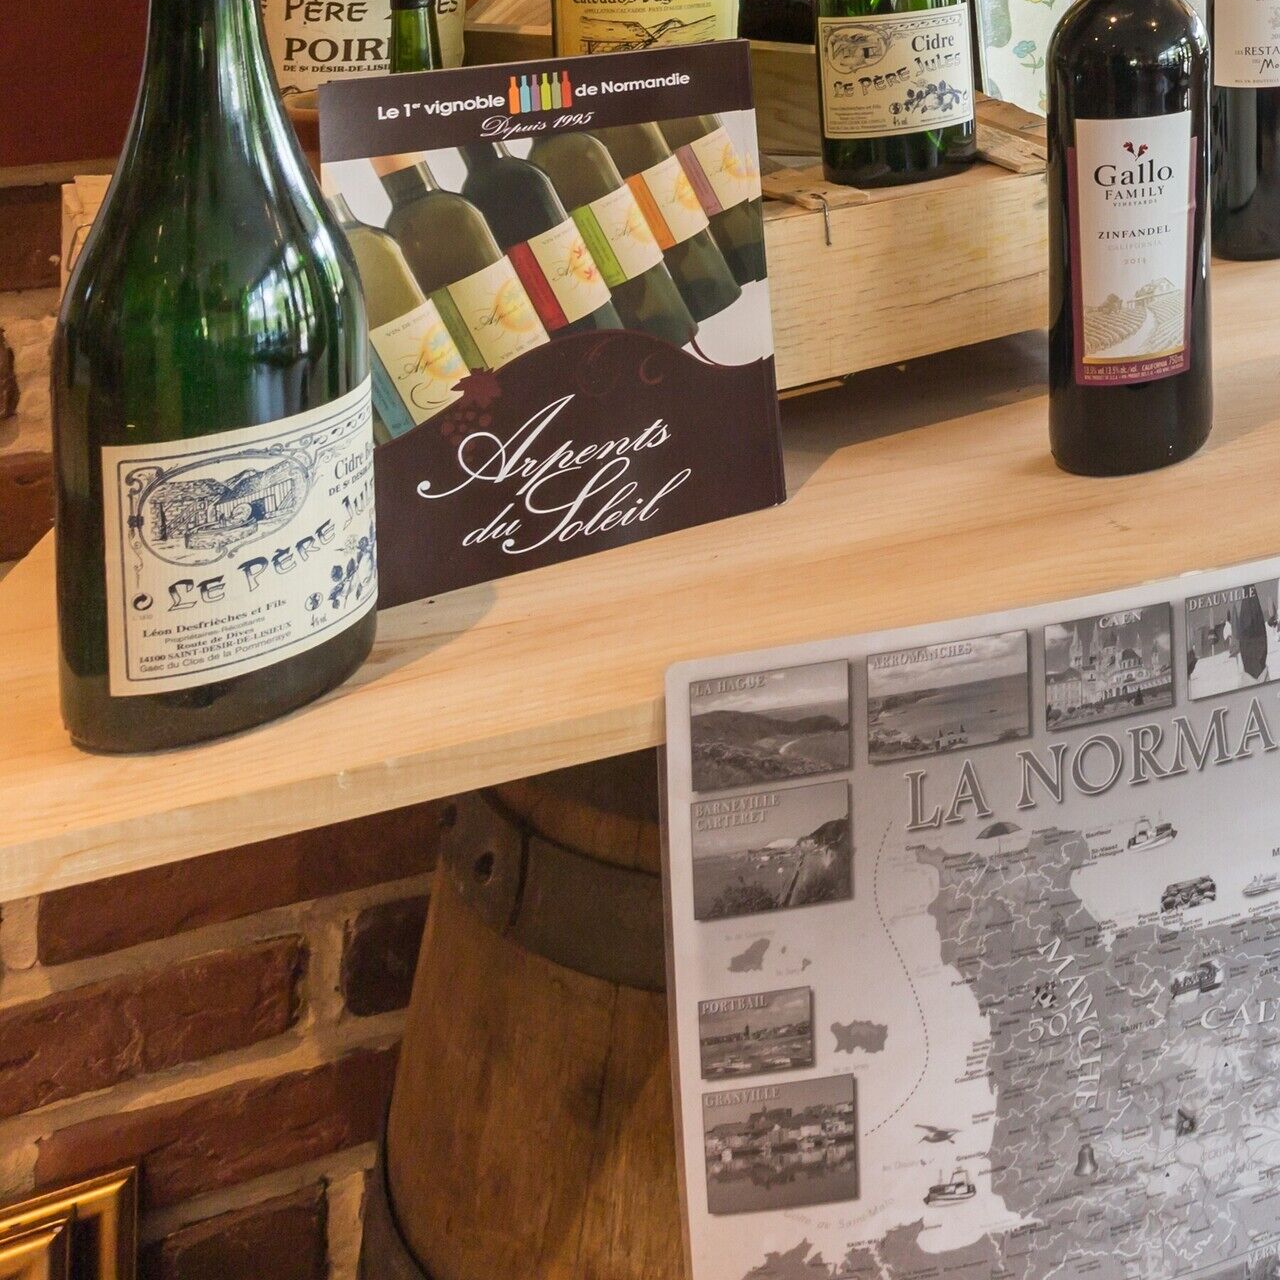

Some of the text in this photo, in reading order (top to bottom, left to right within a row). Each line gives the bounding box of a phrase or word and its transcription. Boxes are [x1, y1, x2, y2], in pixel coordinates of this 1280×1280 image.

[911, 32, 955, 52] Cidre
[283, 64, 297, 72] DE
[377, 105, 401, 122] Le
[423, 94, 506, 118] vignoble
[574, 81, 598, 98] de
[601, 71, 691, 95] Normandie
[833, 81, 855, 98] LE
[479, 111, 596, 140] Depuis 1995
[1093, 158, 1173, 187] Gallo
[1105, 185, 1165, 200] FAMILY
[1113, 199, 1158, 208] VINEYARDS
[1097, 224, 1172, 240] ZINFANDEL
[1106, 239, 1165, 252] CALIFORNIA
[416, 393, 672, 500] Arpents
[461, 456, 692, 555] du Soleil
[167, 519, 337, 612] LE PÈRE
[1187, 586, 1257, 613] DEAUVILLE
[142, 624, 172, 638] Léon
[250, 606, 262, 616] et
[266, 598, 287, 611] Fils
[1097, 609, 1143, 631] CAEN
[176, 627, 254, 652] Route de Dives
[167, 661, 180, 671] du
[182, 656, 205, 668] Clos
[208, 651, 221, 662] de
[223, 648, 232, 658] la
[871, 642, 974, 671] ARROMANCHES
[694, 674, 768, 698] LA HAGUE
[694, 794, 781, 819] BARNEVILLE
[902, 757, 994, 832] LA
[694, 810, 769, 833] CARTERET
[701, 994, 768, 1016] PORTBAIL
[1027, 1012, 1068, 1043] 50
[1036, 935, 1102, 1110] MANCHE
[704, 1086, 782, 1108] GRANVILLE
